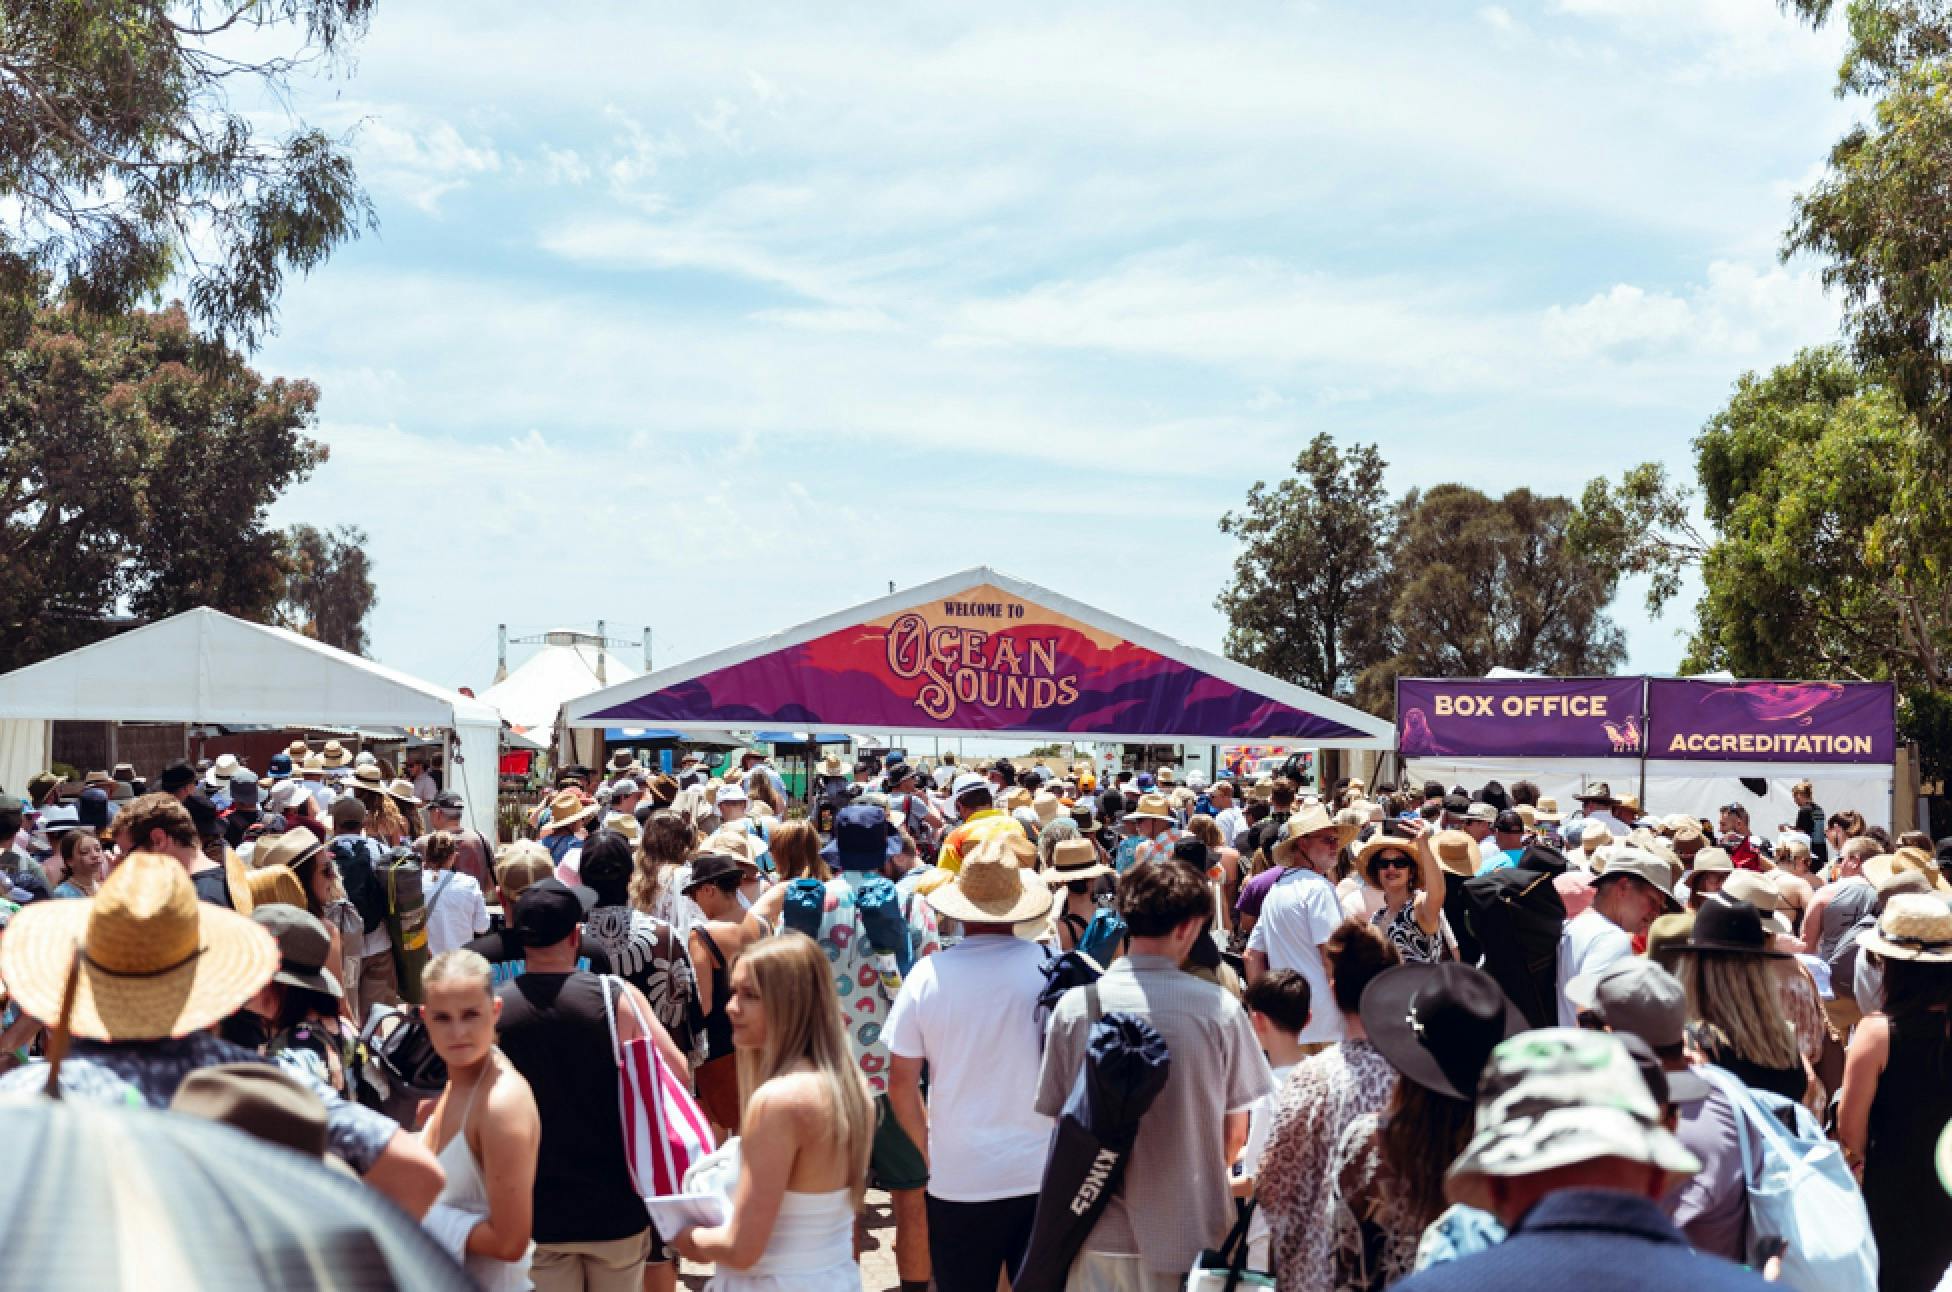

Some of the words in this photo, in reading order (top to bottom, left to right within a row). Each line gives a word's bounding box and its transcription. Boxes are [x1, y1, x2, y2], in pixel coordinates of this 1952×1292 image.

[944, 602, 1002, 618] WELCOME
[1007, 604, 1024, 618] TO
[886, 613, 1057, 678] OCEAN
[914, 654, 1079, 720] SOUNDS
[1434, 695, 1494, 716] BOX
[1501, 695, 1608, 716] OFFICE
[1669, 733, 1873, 754] ACCREDITATION
[1069, 1148, 1120, 1216] KINGS
